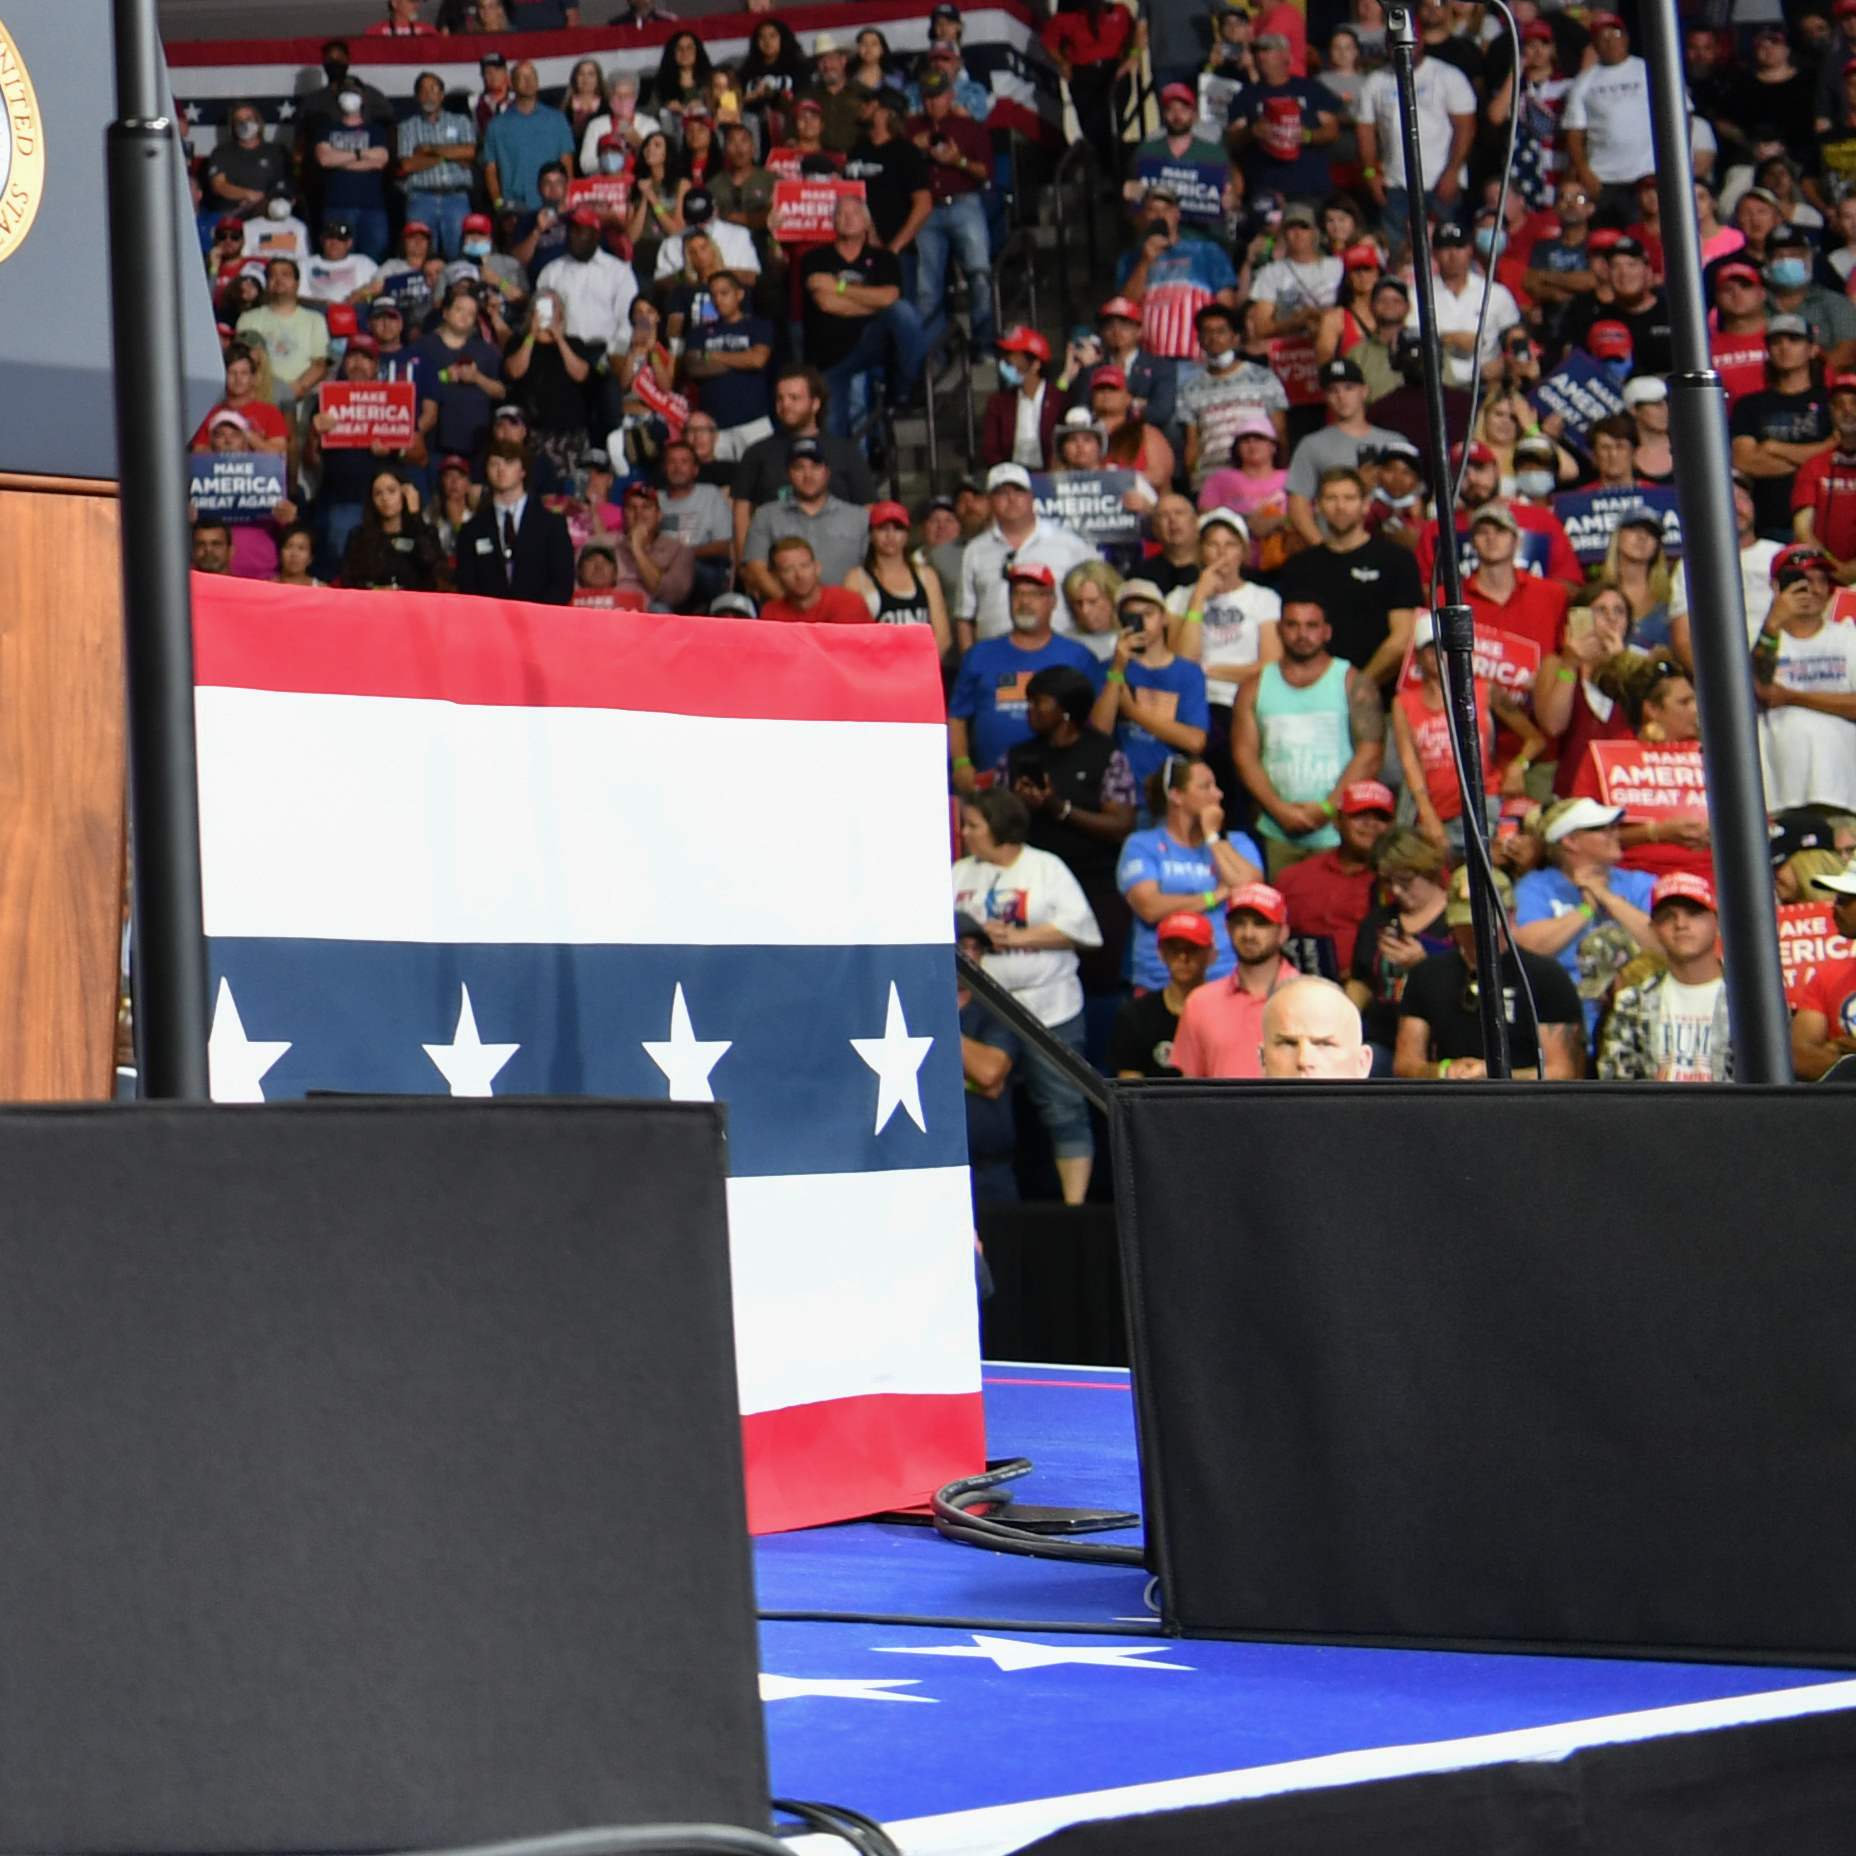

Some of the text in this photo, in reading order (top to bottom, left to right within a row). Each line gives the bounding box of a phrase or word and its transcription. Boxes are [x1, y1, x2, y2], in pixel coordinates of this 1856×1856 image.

[779, 201, 837, 216] AMERI
[349, 390, 388, 403] MAKE
[327, 404, 410, 423] AMERICA
[212, 461, 255, 476] MAKE
[189, 476, 282, 494] AMERICA
[1057, 480, 1101, 496] MAKE
[1591, 496, 1644, 512] MAKE
[1472, 655, 1536, 687] RICA
[1641, 751, 1702, 768] MAKE
[1608, 764, 1705, 789] AMERI
[1610, 787, 1676, 808] GREAT
